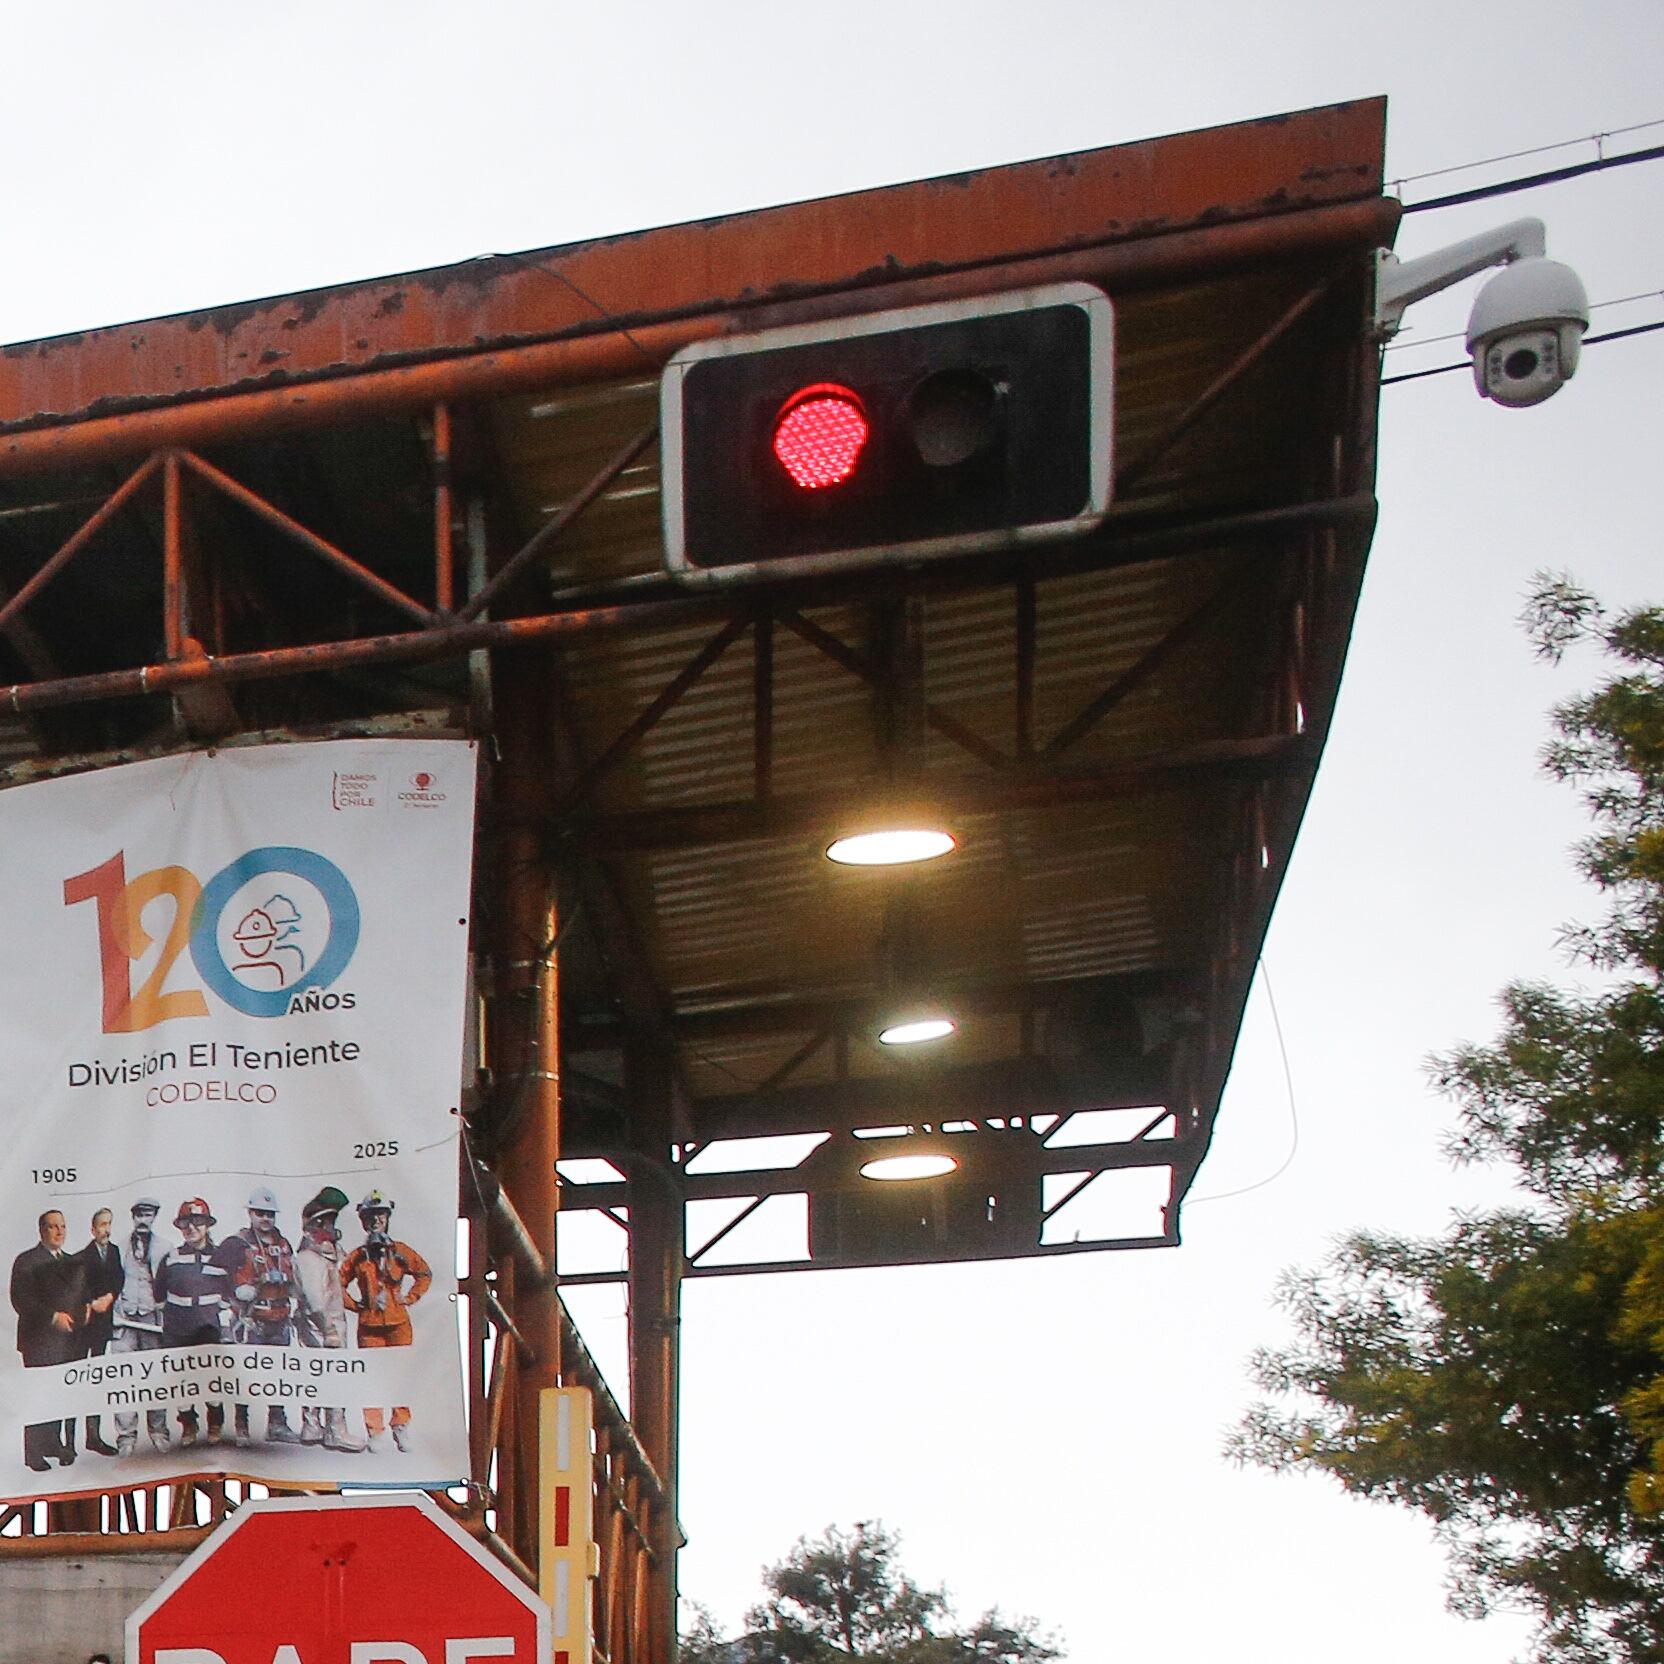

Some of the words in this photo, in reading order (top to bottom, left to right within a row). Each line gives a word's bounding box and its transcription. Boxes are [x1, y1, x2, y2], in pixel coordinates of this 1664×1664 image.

[339, 797, 375, 807] CHILE
[398, 792, 447, 801] CODELCO
[63, 846, 360, 1034] 120
[288, 990, 357, 1015] AÑOS
[68, 1048, 177, 1087] División
[189, 1042, 216, 1068] El
[225, 1040, 360, 1070] Teniente
[145, 1081, 278, 1107] CODELCO
[353, 1141, 400, 1160] 2025
[31, 1168, 78, 1184] 1905
[63, 1362, 134, 1386] Origen
[139, 1360, 154, 1380] y
[159, 1353, 235, 1374] futuro
[244, 1352, 274, 1371] de
[282, 1352, 301, 1372] la
[309, 1357, 366, 1379] gran
[106, 1378, 201, 1405] minería
[208, 1376, 240, 1396] del
[248, 1379, 318, 1399] cobre
